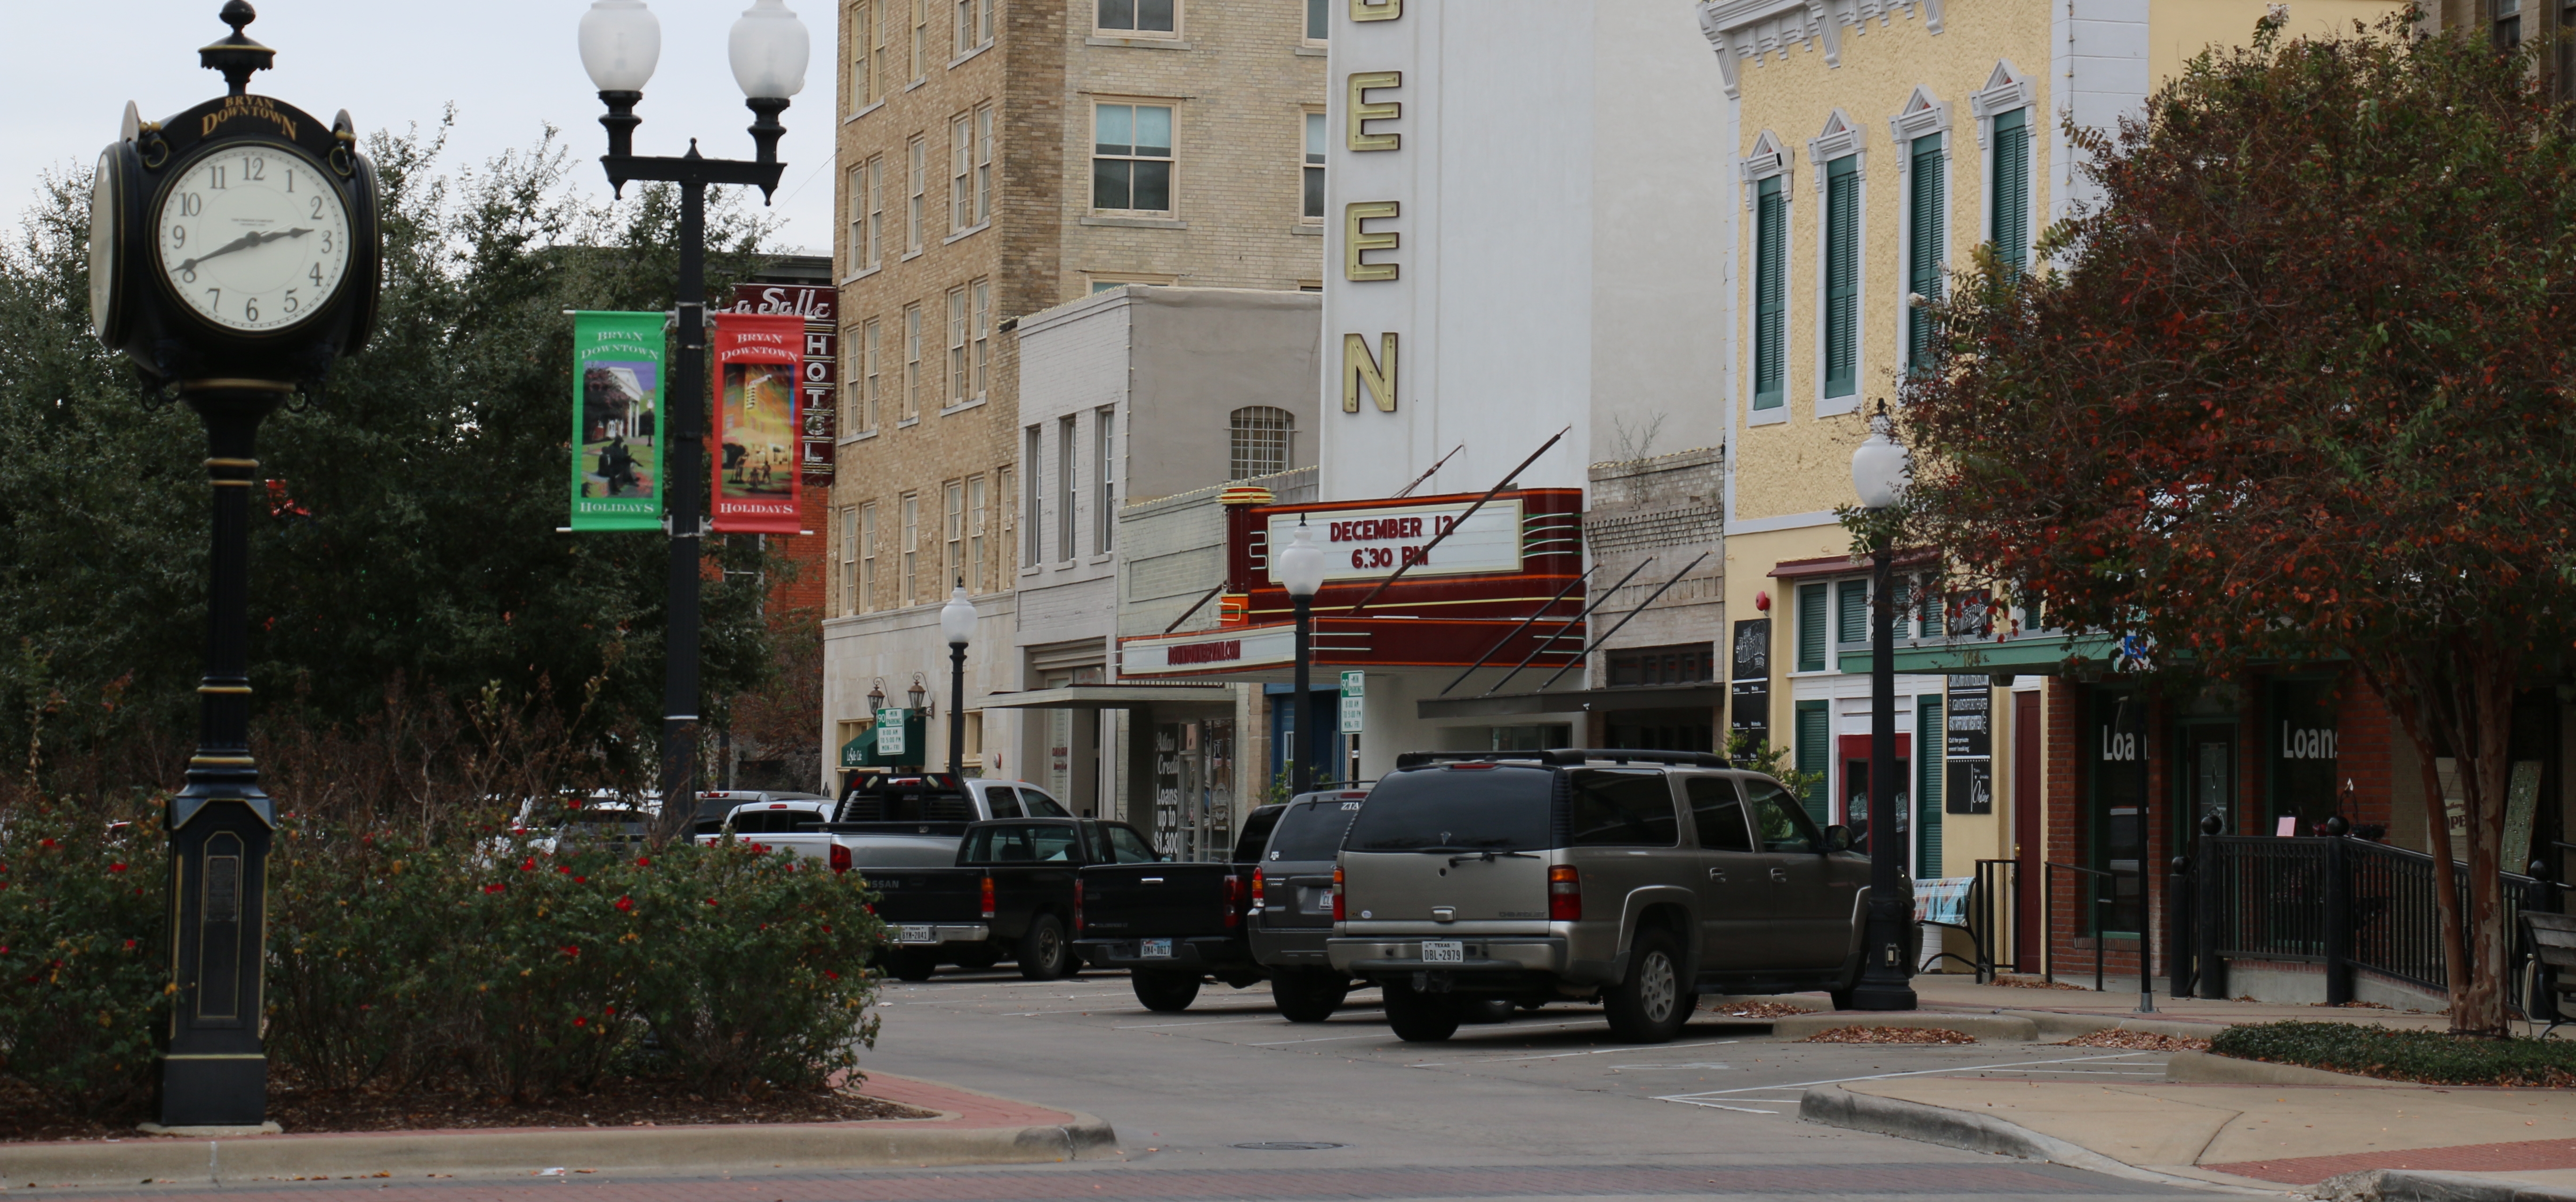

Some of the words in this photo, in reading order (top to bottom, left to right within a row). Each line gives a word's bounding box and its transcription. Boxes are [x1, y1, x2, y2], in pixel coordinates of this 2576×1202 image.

[225, 96, 274, 109] BRYAN
[201, 105, 297, 141] DOWNTOWN
[209, 165, 226, 190] 11
[242, 157, 266, 180] 12
[286, 169, 294, 193] 1
[180, 192, 201, 217] 10
[310, 196, 324, 220] 2
[1343, 0, 1403, 413] EEN
[173, 226, 185, 249] 9
[322, 230, 332, 254] 3
[309, 262, 323, 287] 4
[206, 288, 220, 313] 7
[245, 298, 258, 322] 6
[284, 288, 298, 313] 5
[757, 288, 831, 318] Salle
[597, 331, 644, 342] BRYAN
[737, 333, 783, 344] BRYAN
[581, 344, 659, 360] DOWNTOWN
[721, 346, 798, 363] DOWNTOWN
[805, 335, 827, 462] HOTEL
[580, 502, 654, 513] HOLIDAYS
[720, 503, 794, 514] HOLIDAYS
[1330, 517, 1422, 542] DECEMBER
[1435, 516, 1453, 535] 12
[1352, 547, 1393, 569] 6:30
[1401, 545, 1428, 566] PM
[1342, 679, 1348, 691] 90
[877, 714, 886, 723] 90
[1156, 732, 1175, 752] Atlas
[2103, 725, 2148, 761] Loa
[2283, 719, 2338, 759] Loan
[1158, 754, 1178, 774] Credi
[1157, 783, 1177, 805] Loans
[1157, 810, 1167, 831] up
[1168, 806, 1176, 827] to
[869, 880, 900, 888] ISSAN
